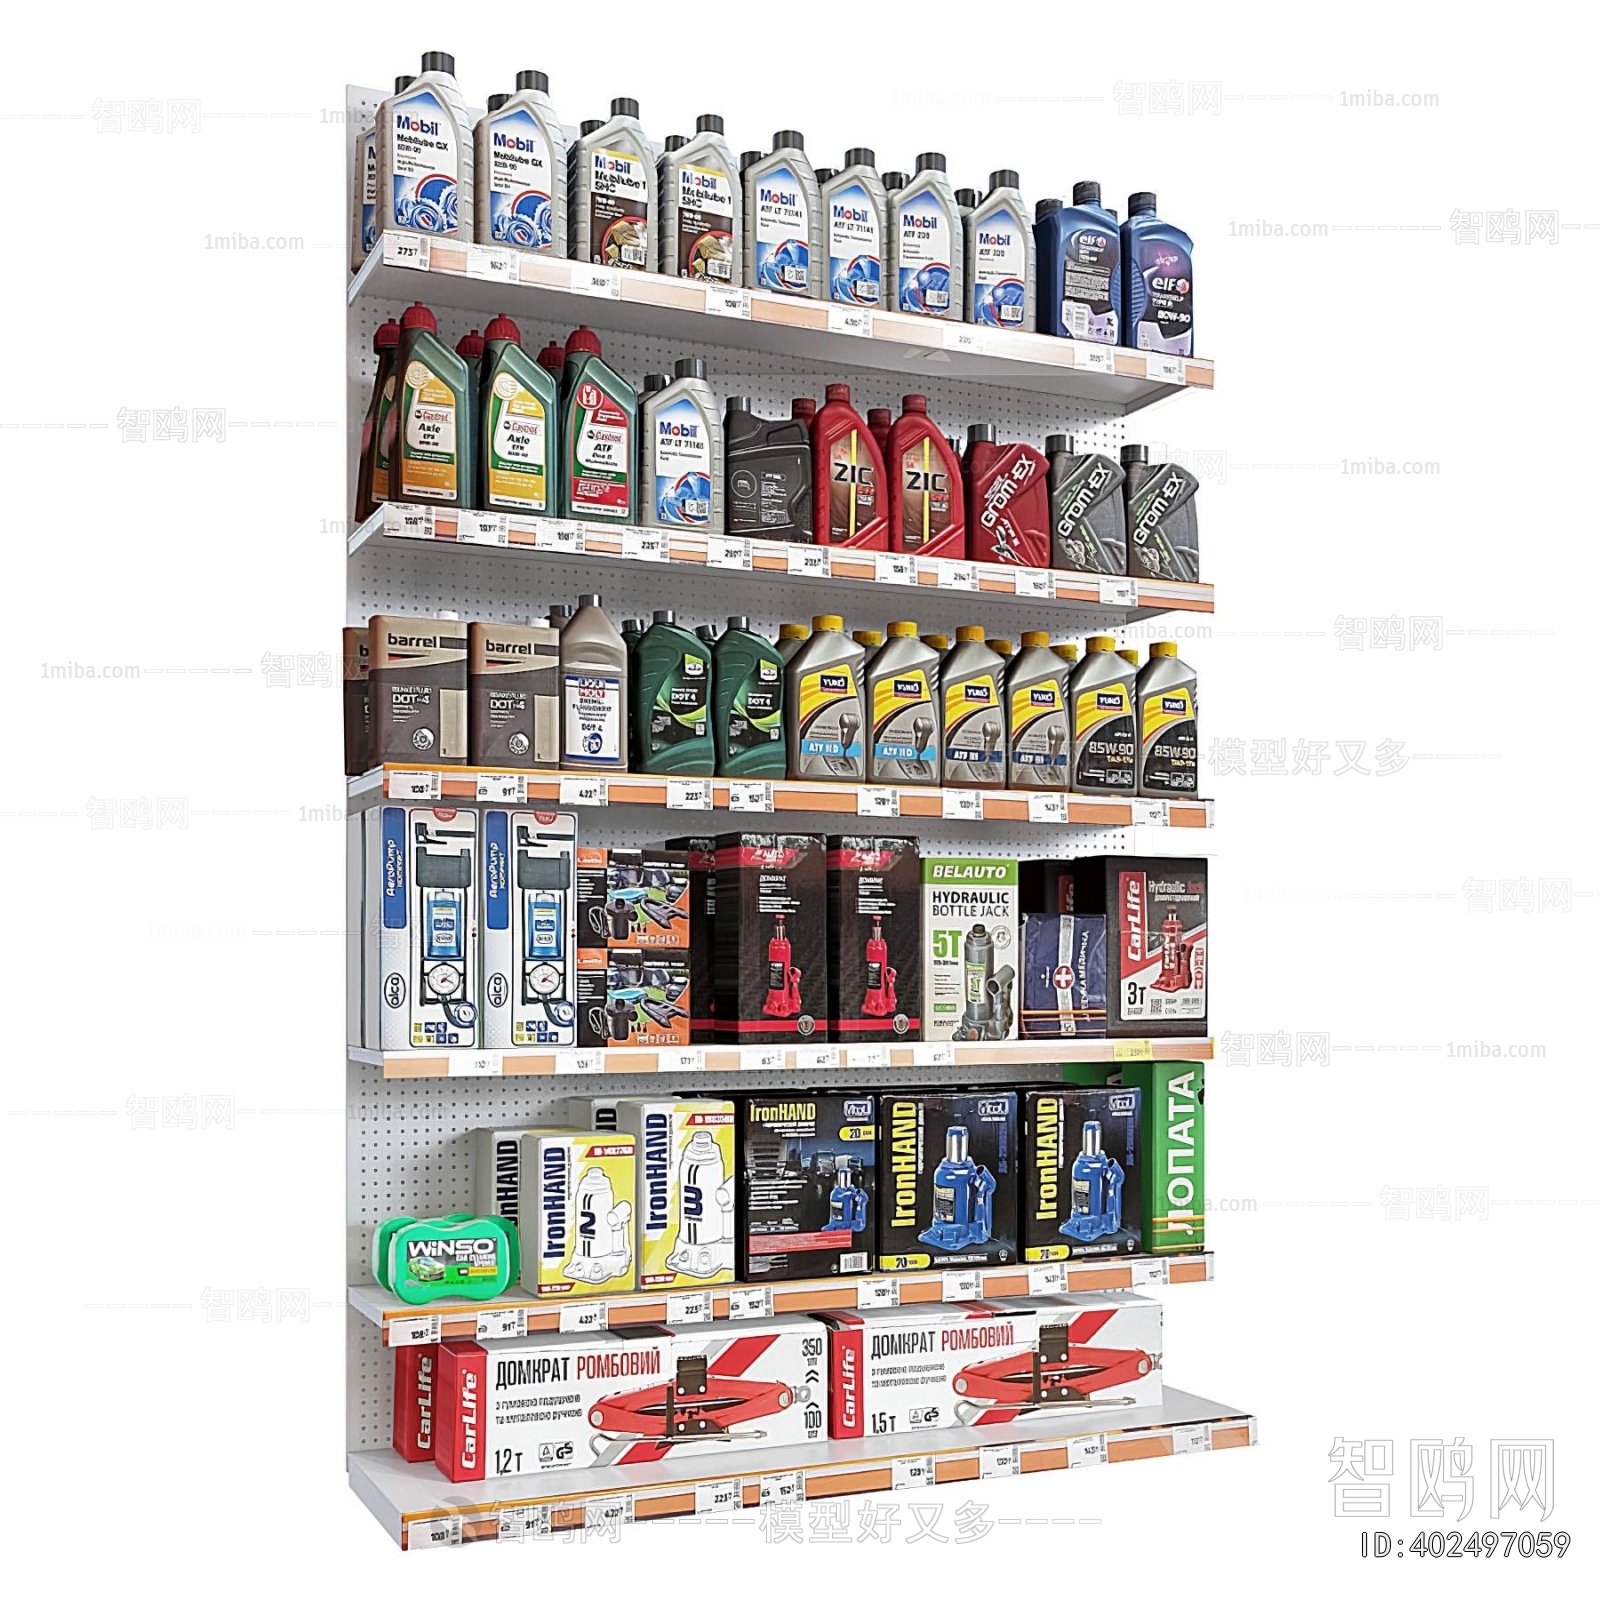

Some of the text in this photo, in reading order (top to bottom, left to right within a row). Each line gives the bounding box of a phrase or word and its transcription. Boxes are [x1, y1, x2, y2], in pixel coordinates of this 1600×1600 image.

[397, 115, 439, 136] Mobil
[494, 133, 535, 153] Mobil
[595, 155, 631, 174] Mobil
[682, 172, 717, 190] Mobil
[760, 189, 797, 207] Mobil
[833, 205, 869, 222] Mobil
[903, 215, 937, 229] Mobil
[979, 233, 1011, 246] Mobil
[1079, 235, 1097, 245] elf
[1152, 277, 1176, 290] elf
[423, 410, 449, 422] Castrol
[511, 422, 538, 435] Castrol
[595, 431, 623, 443] Castrol
[660, 421, 698, 438] Mobil
[507, 434, 530, 445] Axle
[594, 443, 613, 453] ATF
[834, 463, 873, 486] ZIC
[906, 470, 948, 493] ZIC
[388, 633, 437, 648] barrel
[486, 639, 532, 656] barrel
[579, 688, 606, 698] MOLY
[672, 693, 689, 701] DOT
[1089, 742, 1134, 756] 85W-90
[932, 864, 1008, 879] BELAUTO
[932, 891, 1009, 904] HYDRAULIC
[932, 905, 1009, 917] BOTTLE JACK
[1127, 880, 1141, 962] CarLife
[750, 1103, 816, 1122] IronHAND
[1036, 1097, 1058, 1221] IronHAND
[1167, 1071, 1195, 1236] ЛОПАТА
[646, 1113, 668, 1230] IronHAND
[891, 1101, 917, 1228] IronHAND
[543, 1147, 566, 1259] IronHAND
[408, 1239, 494, 1257] WiNSO
[802, 1337, 822, 1357] 350
[871, 1321, 1014, 1361] ДОМКРАТ РОМБОВИЙ
[495, 1346, 660, 1391] ДОМКРАТ РОМБОВИЙ
[841, 1348, 856, 1428] CarLife
[417, 1356, 433, 1449] CarLife
[461, 1372, 477, 1470] CarLife
[804, 1410, 821, 1430] 100
